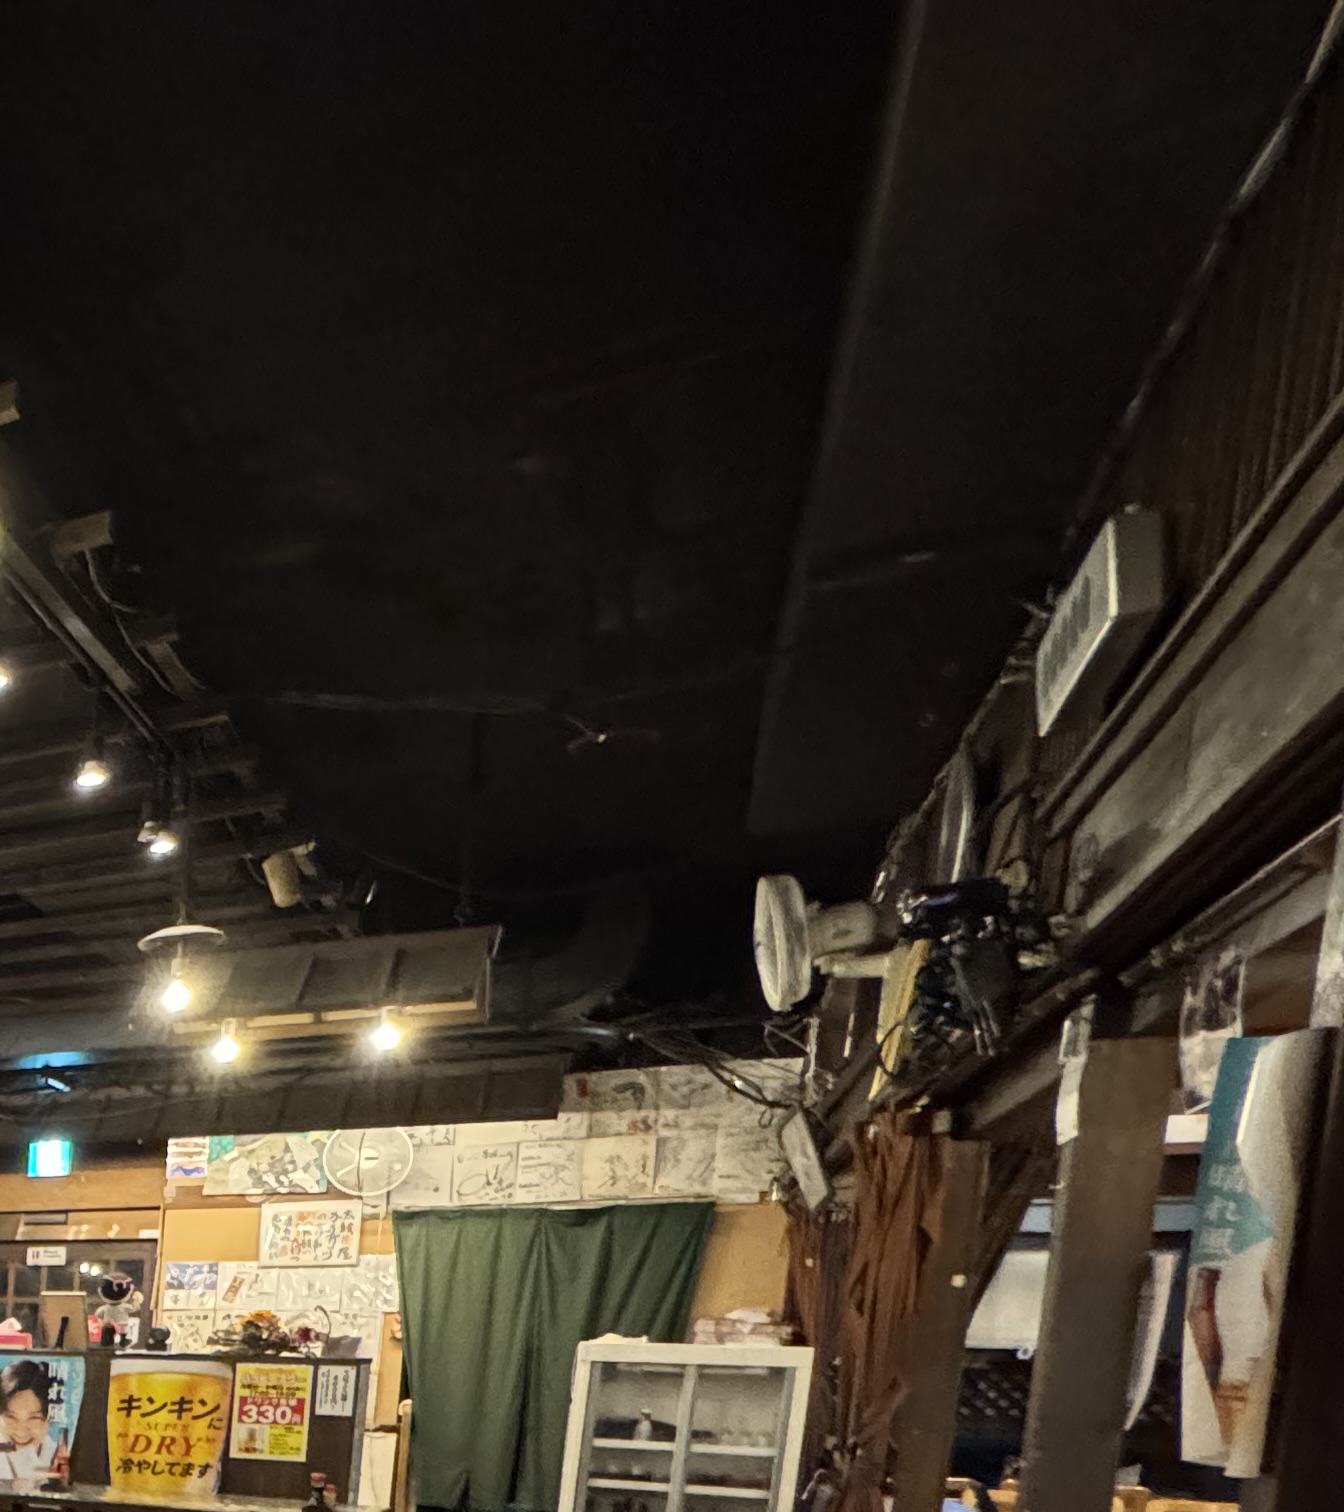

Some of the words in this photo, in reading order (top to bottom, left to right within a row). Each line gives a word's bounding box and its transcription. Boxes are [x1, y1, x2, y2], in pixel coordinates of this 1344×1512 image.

[129, 1434, 200, 1457] DRY
[116, 1458, 213, 1479] 冷やしてます
